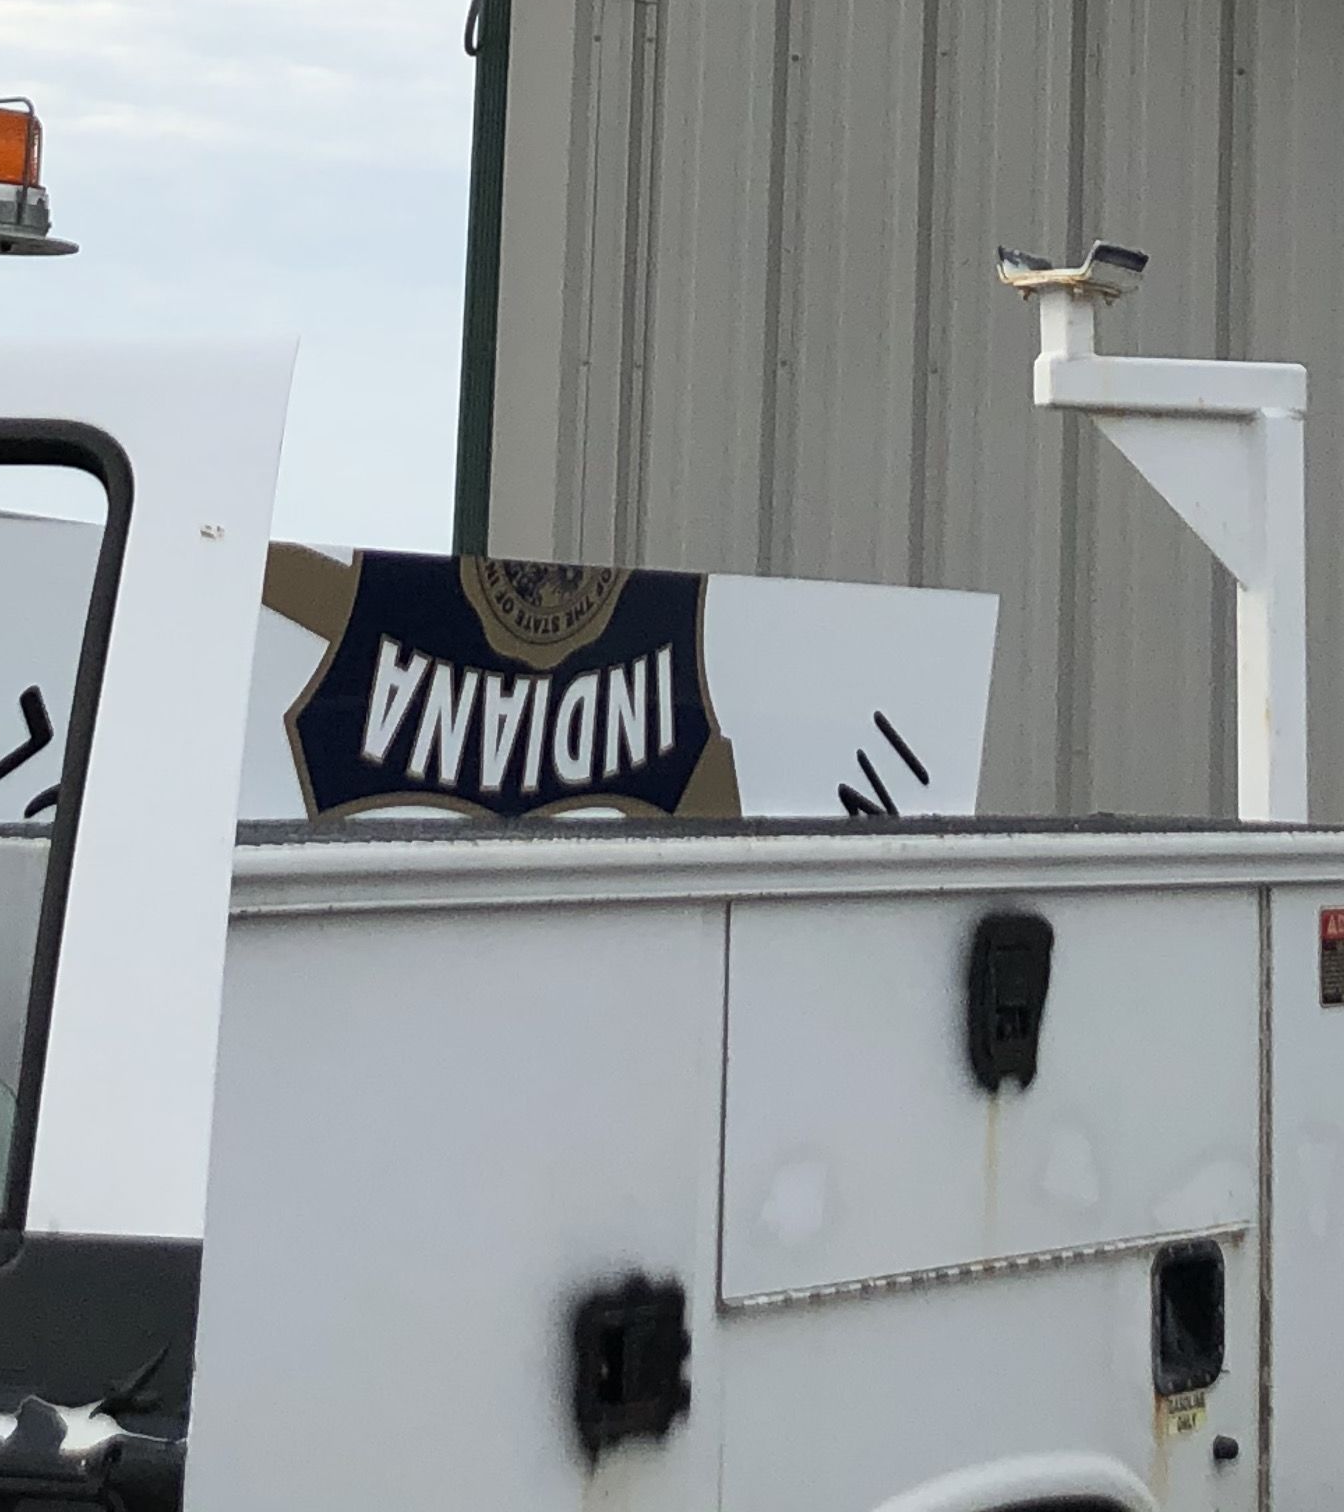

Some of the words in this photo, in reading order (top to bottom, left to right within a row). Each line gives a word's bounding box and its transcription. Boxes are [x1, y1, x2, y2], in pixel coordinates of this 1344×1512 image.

[493, 590, 515, 614] OF
[566, 595, 594, 627] THE
[514, 608, 561, 635] STATE
[361, 636, 675, 792] INDIANA
